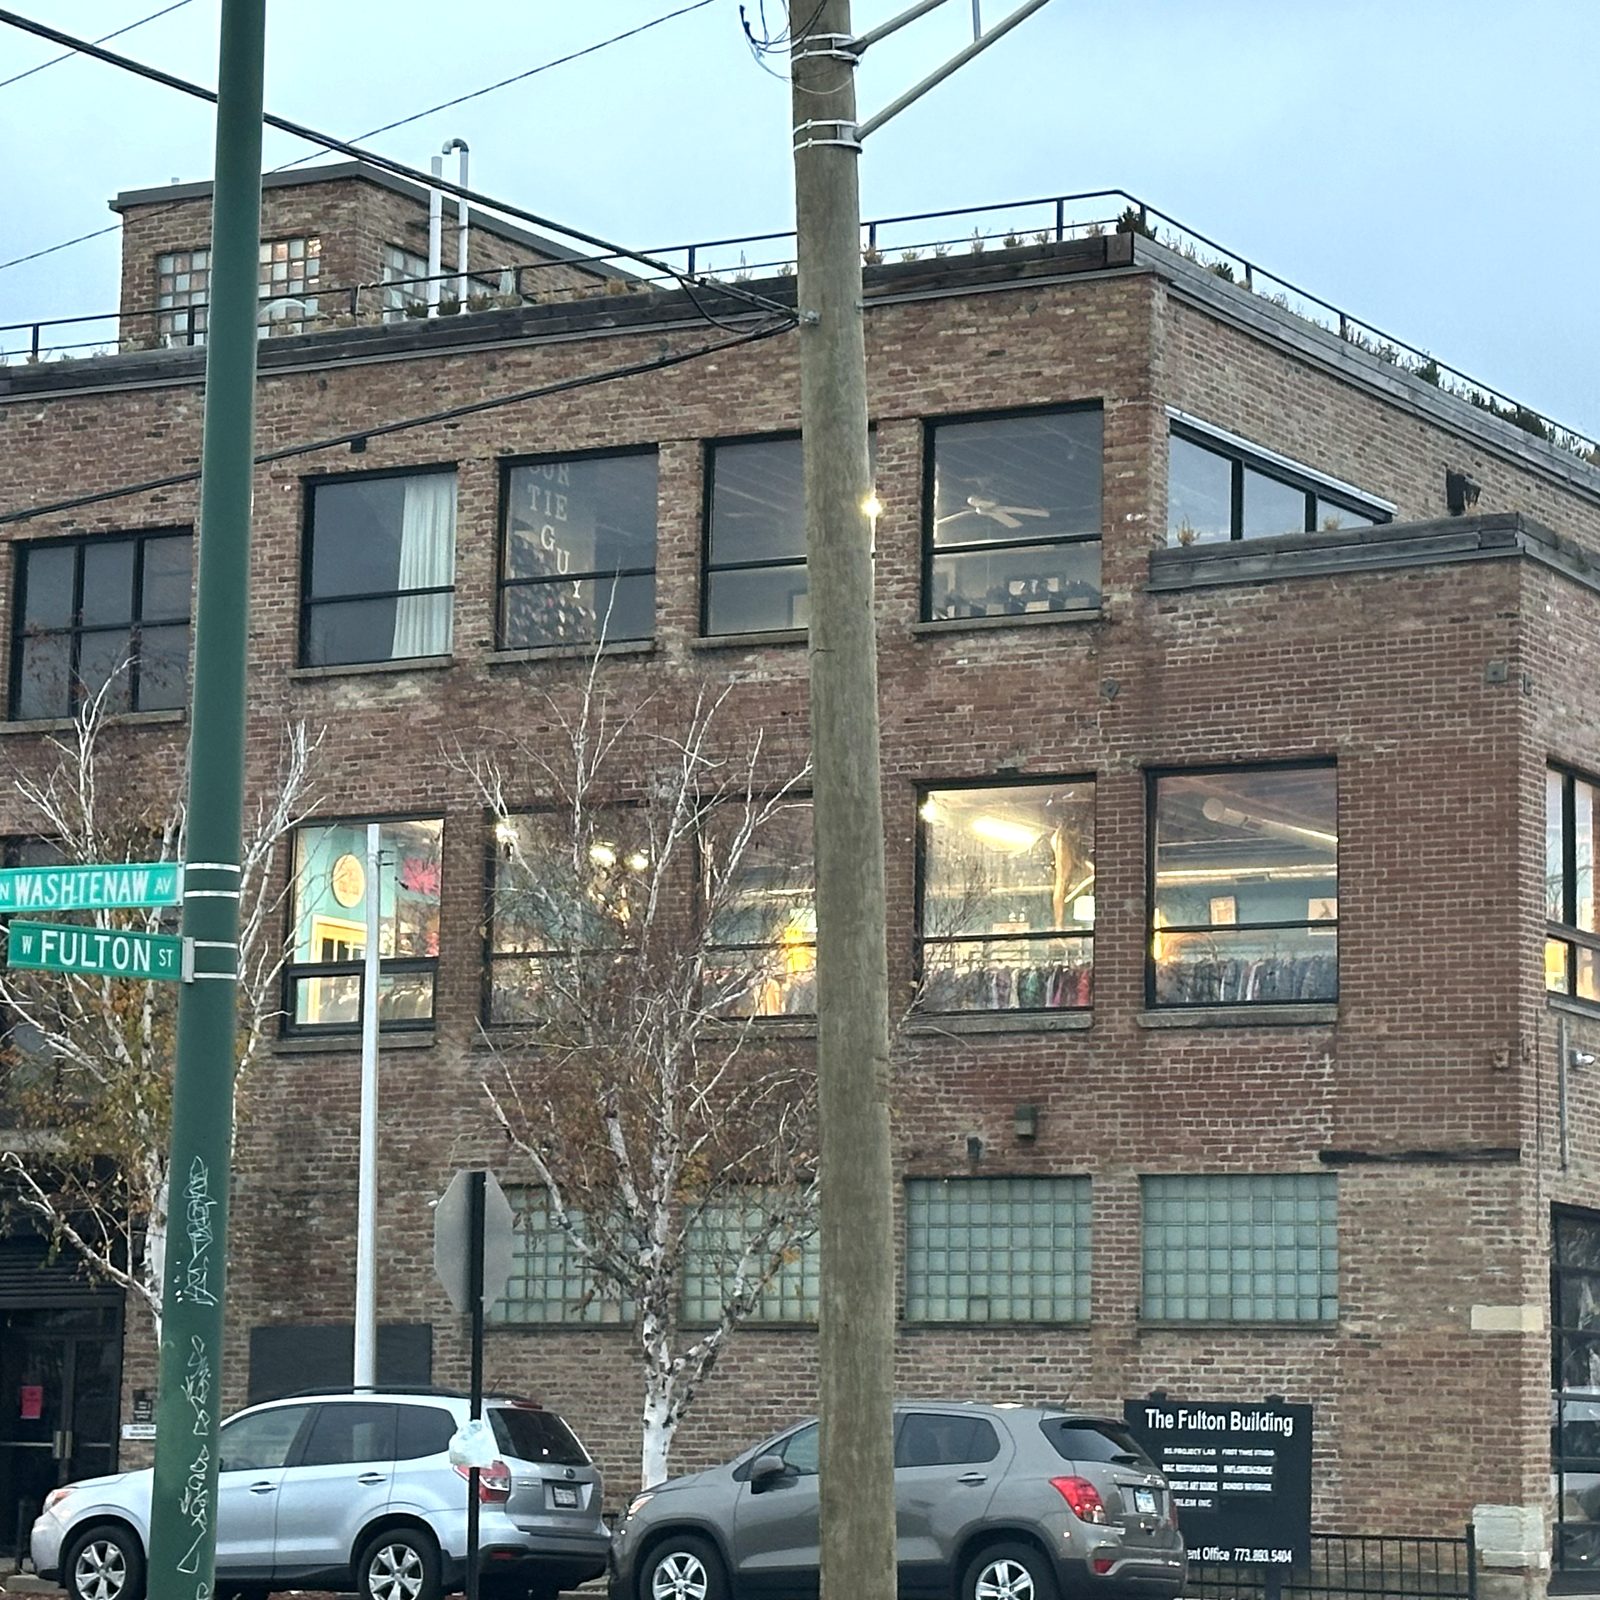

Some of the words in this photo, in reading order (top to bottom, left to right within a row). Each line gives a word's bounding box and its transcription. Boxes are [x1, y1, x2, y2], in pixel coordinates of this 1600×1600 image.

[527, 484, 568, 521] TIE
[541, 524, 582, 599] GUY
[15, 871, 150, 906] WASHTENAW
[154, 876, 173, 895] AV
[22, 936, 33, 954] W
[41, 930, 151, 972] FULTON
[159, 949, 174, 967] ST
[1145, 1408, 1174, 1429] The
[1178, 1409, 1226, 1431] Fulton
[1230, 1411, 1294, 1437] Building
[1202, 1546, 1231, 1561] Office
